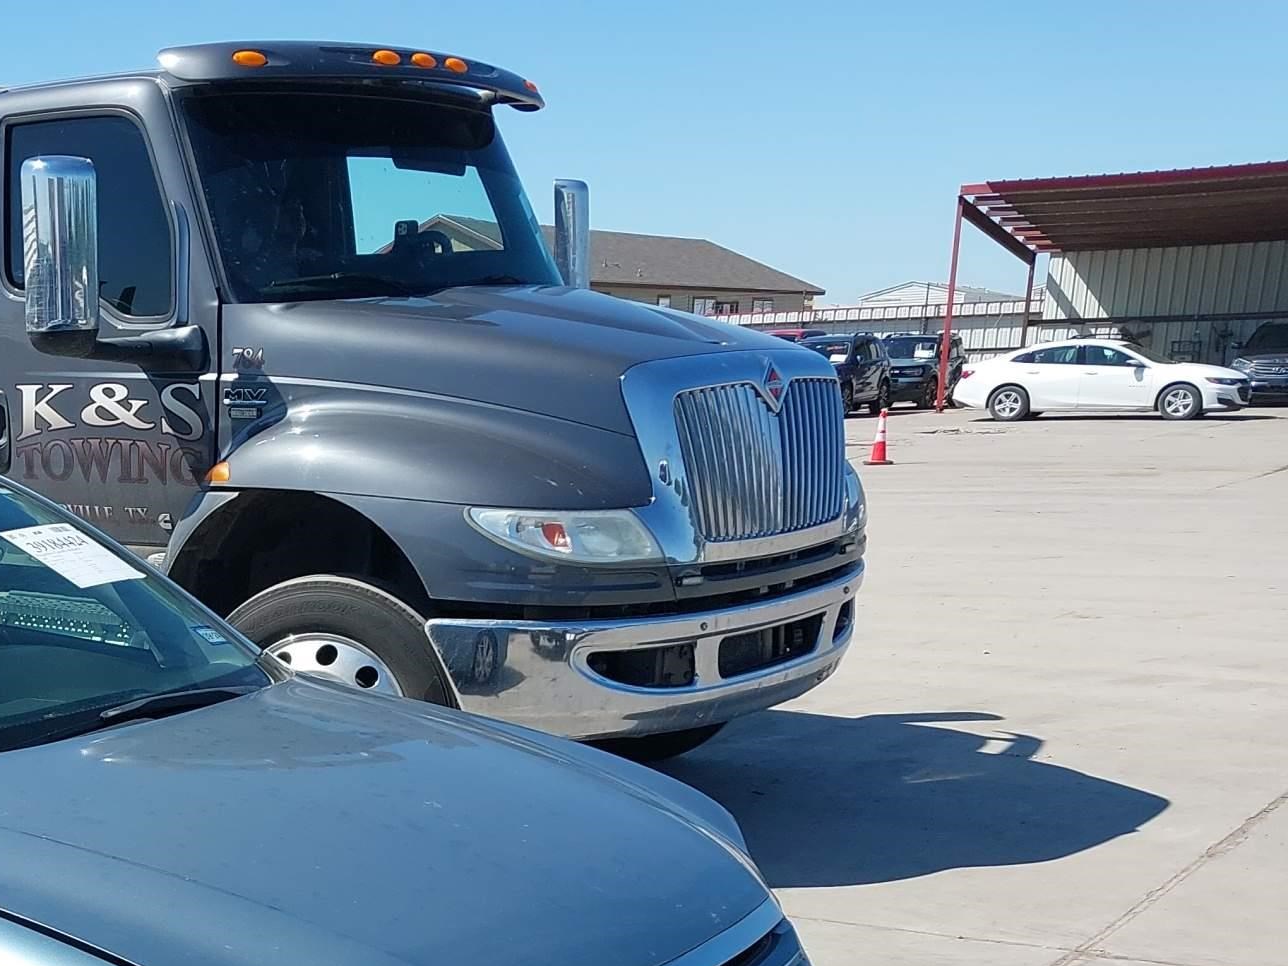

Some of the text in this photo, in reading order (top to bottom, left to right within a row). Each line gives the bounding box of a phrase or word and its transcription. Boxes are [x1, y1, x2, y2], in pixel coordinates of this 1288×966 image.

[232, 347, 264, 369] 784
[223, 388, 267, 401] MV
[16, 437, 203, 487] TOWING
[25, 535, 89, 553] 39184424
